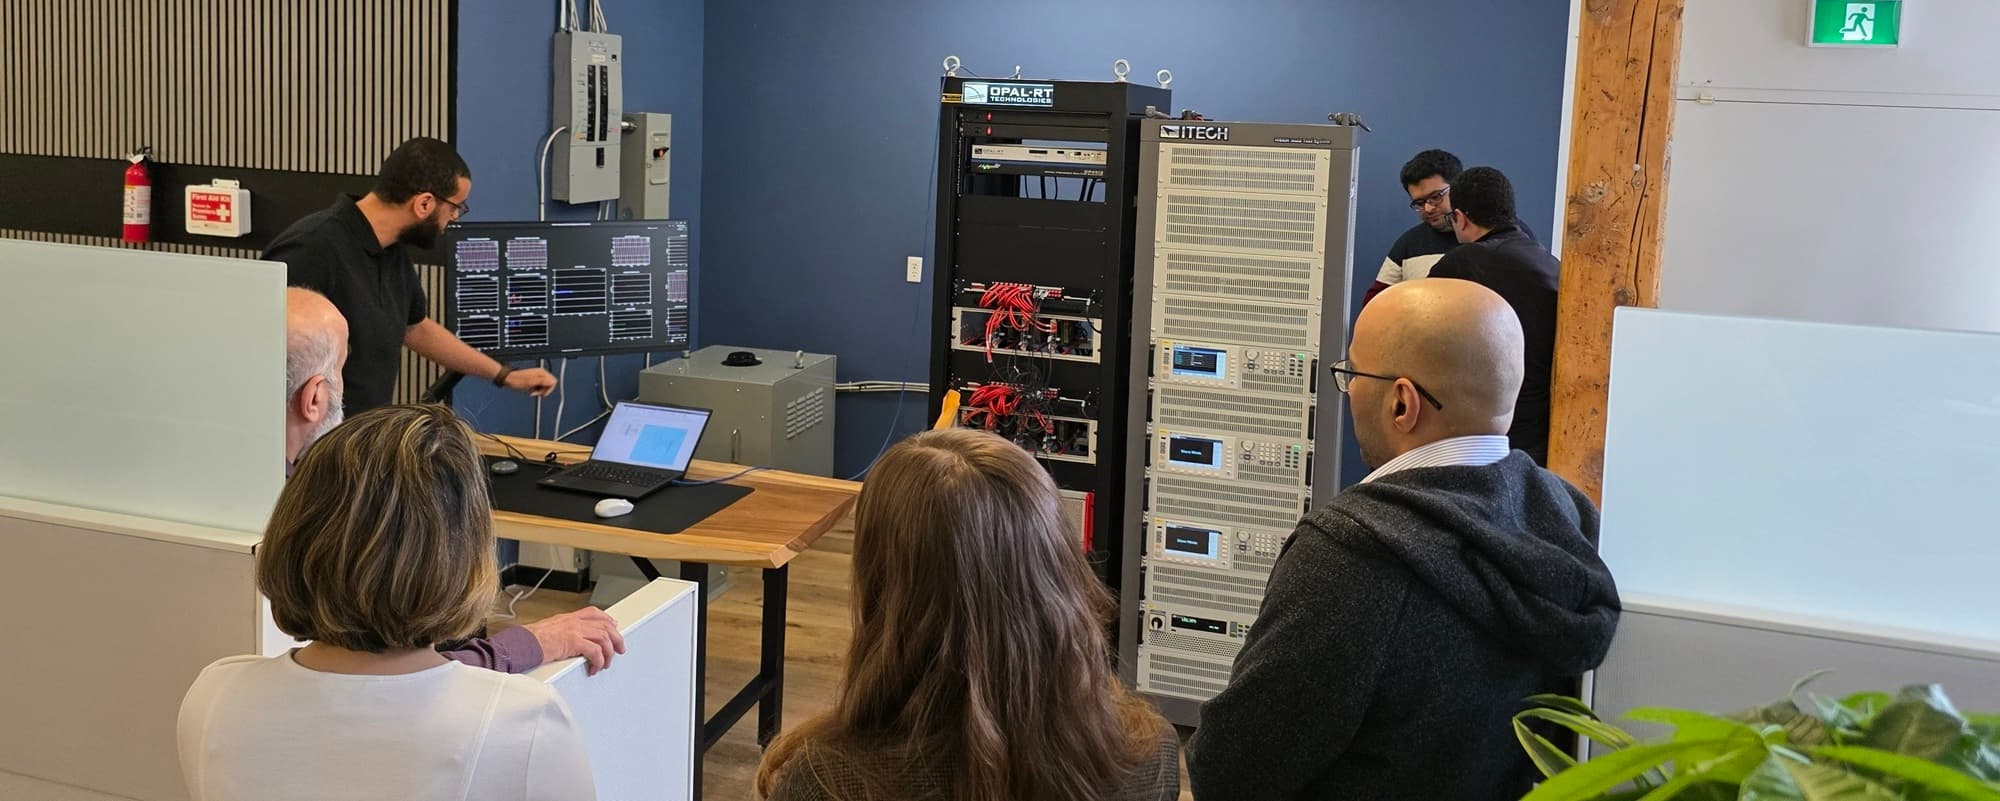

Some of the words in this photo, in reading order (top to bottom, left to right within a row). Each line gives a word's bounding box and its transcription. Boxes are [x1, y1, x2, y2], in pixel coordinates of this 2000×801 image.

[990, 96, 1053, 104] TECHNOLOGIES
[1181, 125, 1228, 140] ITECH
[191, 193, 207, 201] First
[208, 194, 219, 202] Aid
[220, 195, 230, 203] Kit
